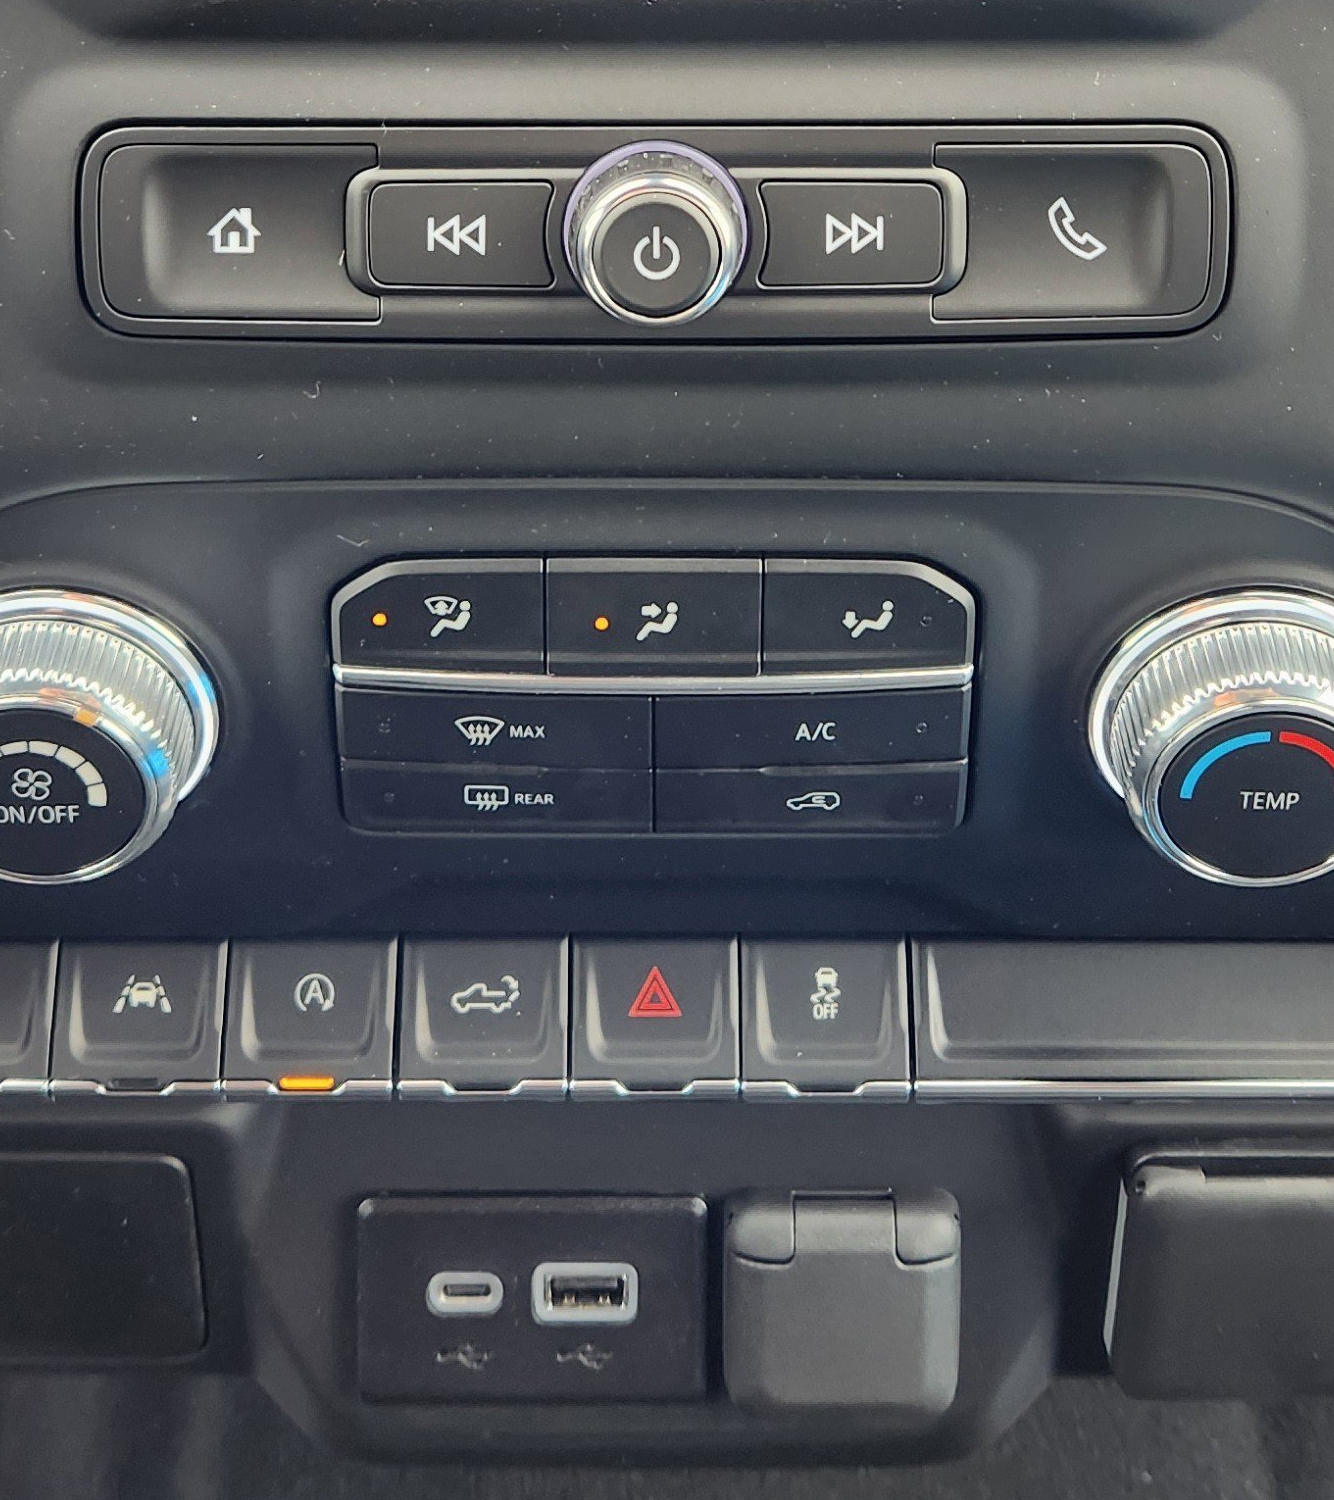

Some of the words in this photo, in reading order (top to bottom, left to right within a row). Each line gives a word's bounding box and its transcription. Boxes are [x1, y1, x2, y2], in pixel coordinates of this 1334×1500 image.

[509, 724, 546, 739] MAX
[795, 722, 837, 742] A/C
[514, 792, 555, 806] REAR
[1240, 791, 1300, 811] TEMP
[812, 1003, 838, 1020] OFF
